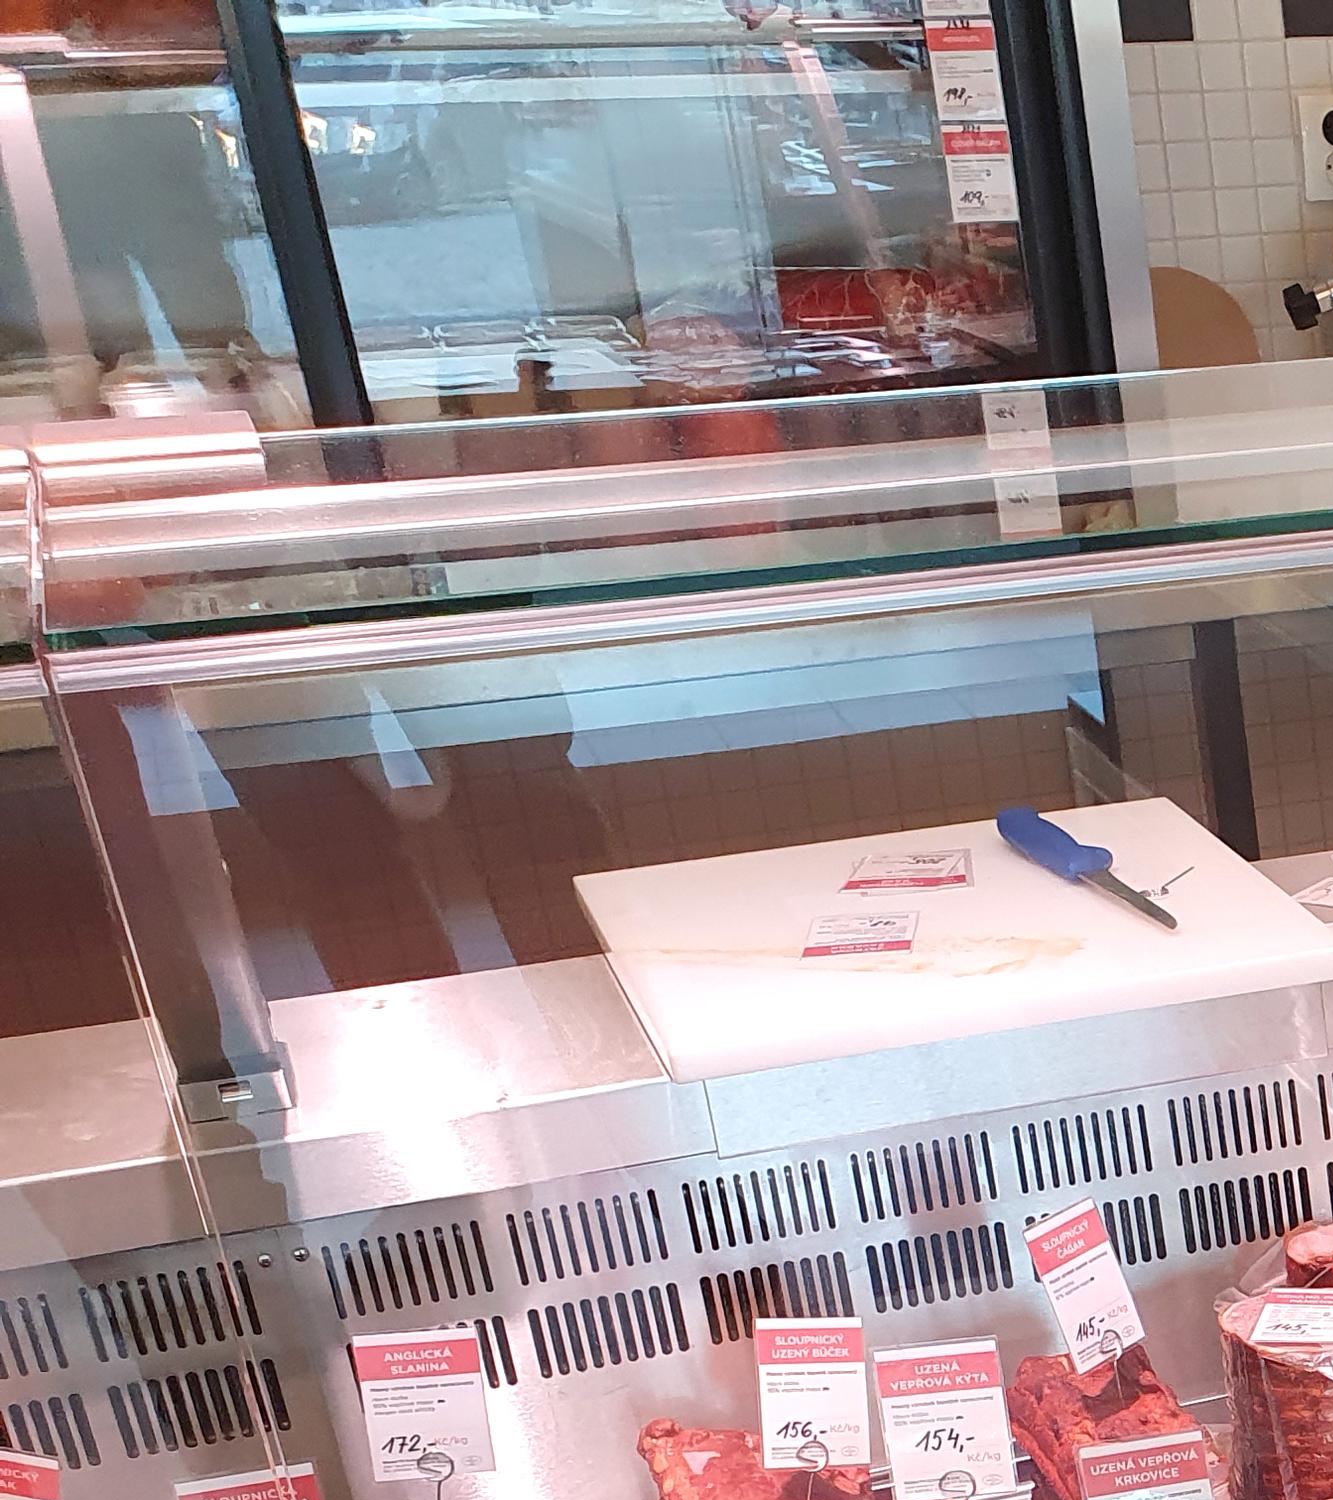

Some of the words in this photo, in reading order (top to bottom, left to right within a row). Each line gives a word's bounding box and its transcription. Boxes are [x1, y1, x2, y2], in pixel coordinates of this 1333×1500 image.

[384, 1346, 453, 1363] ANGLICKÁ
[772, 1347, 809, 1359] UZENÝ
[812, 1345, 849, 1358] BŮČEK
[390, 1362, 449, 1375] SLANINA
[914, 1360, 961, 1375] UZENÁ
[890, 1376, 951, 1392] VEPŘOVÁ
[955, 1372, 989, 1385] KÝTA
[776, 1421, 827, 1441] 156,-
[829, 1423, 860, 1435] Kč/kg
[382, 1434, 437, 1453] 172,-
[915, 1428, 975, 1453] 154,-
[967, 1451, 1001, 1463] Kč/kg
[1090, 1458, 1136, 1476] UZENÁ
[1139, 1448, 1198, 1469] VEPŘOVÁ
[1114, 1467, 1180, 1486] KRKOVICE
